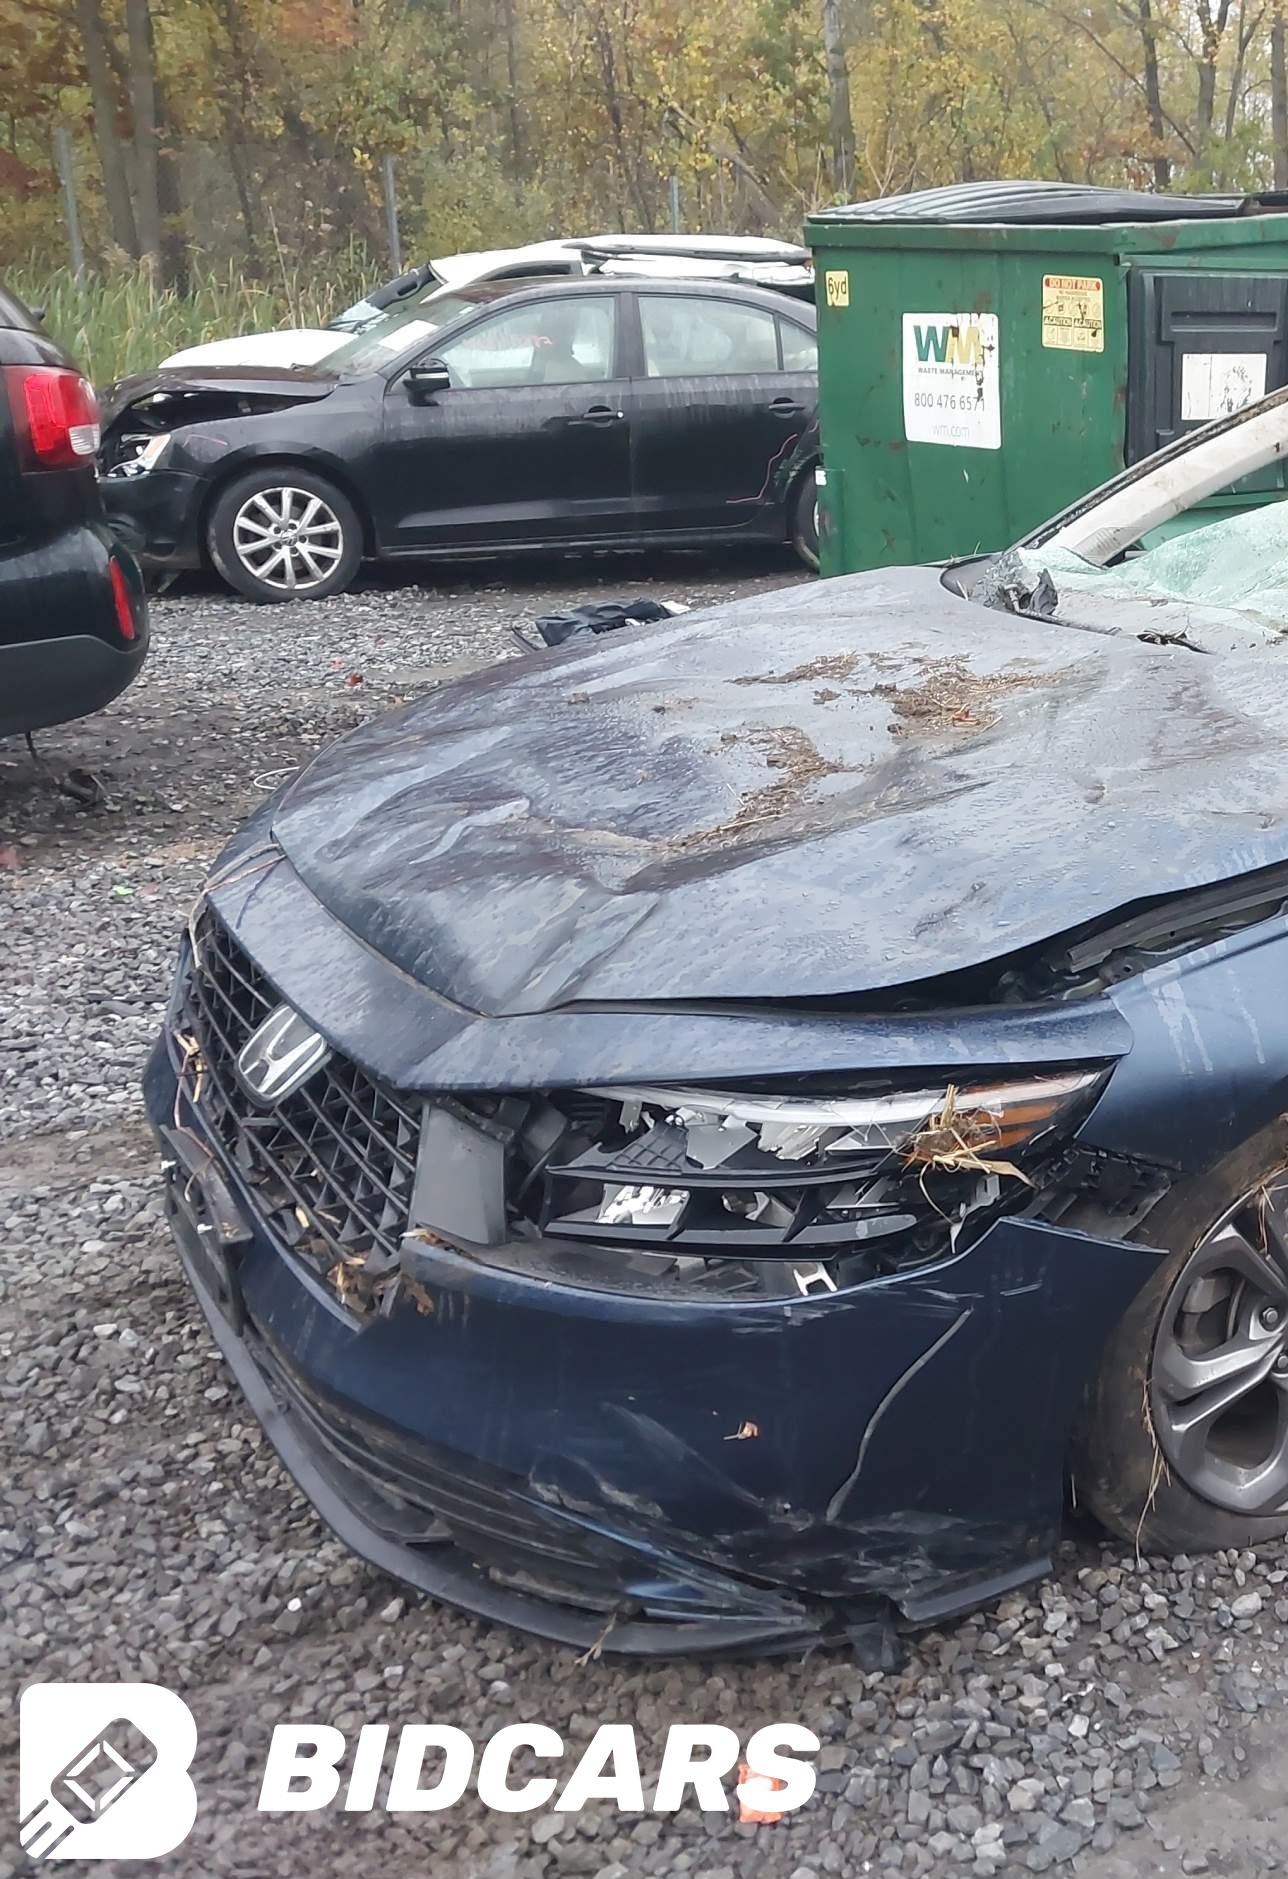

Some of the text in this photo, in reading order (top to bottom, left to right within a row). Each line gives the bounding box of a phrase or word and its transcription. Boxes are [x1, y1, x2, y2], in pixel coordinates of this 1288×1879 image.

[828, 275, 847, 300] 6yd
[913, 325, 983, 365] WM
[918, 367, 938, 375] WASTE
[914, 392, 934, 408] 800
[937, 393, 956, 409] 476
